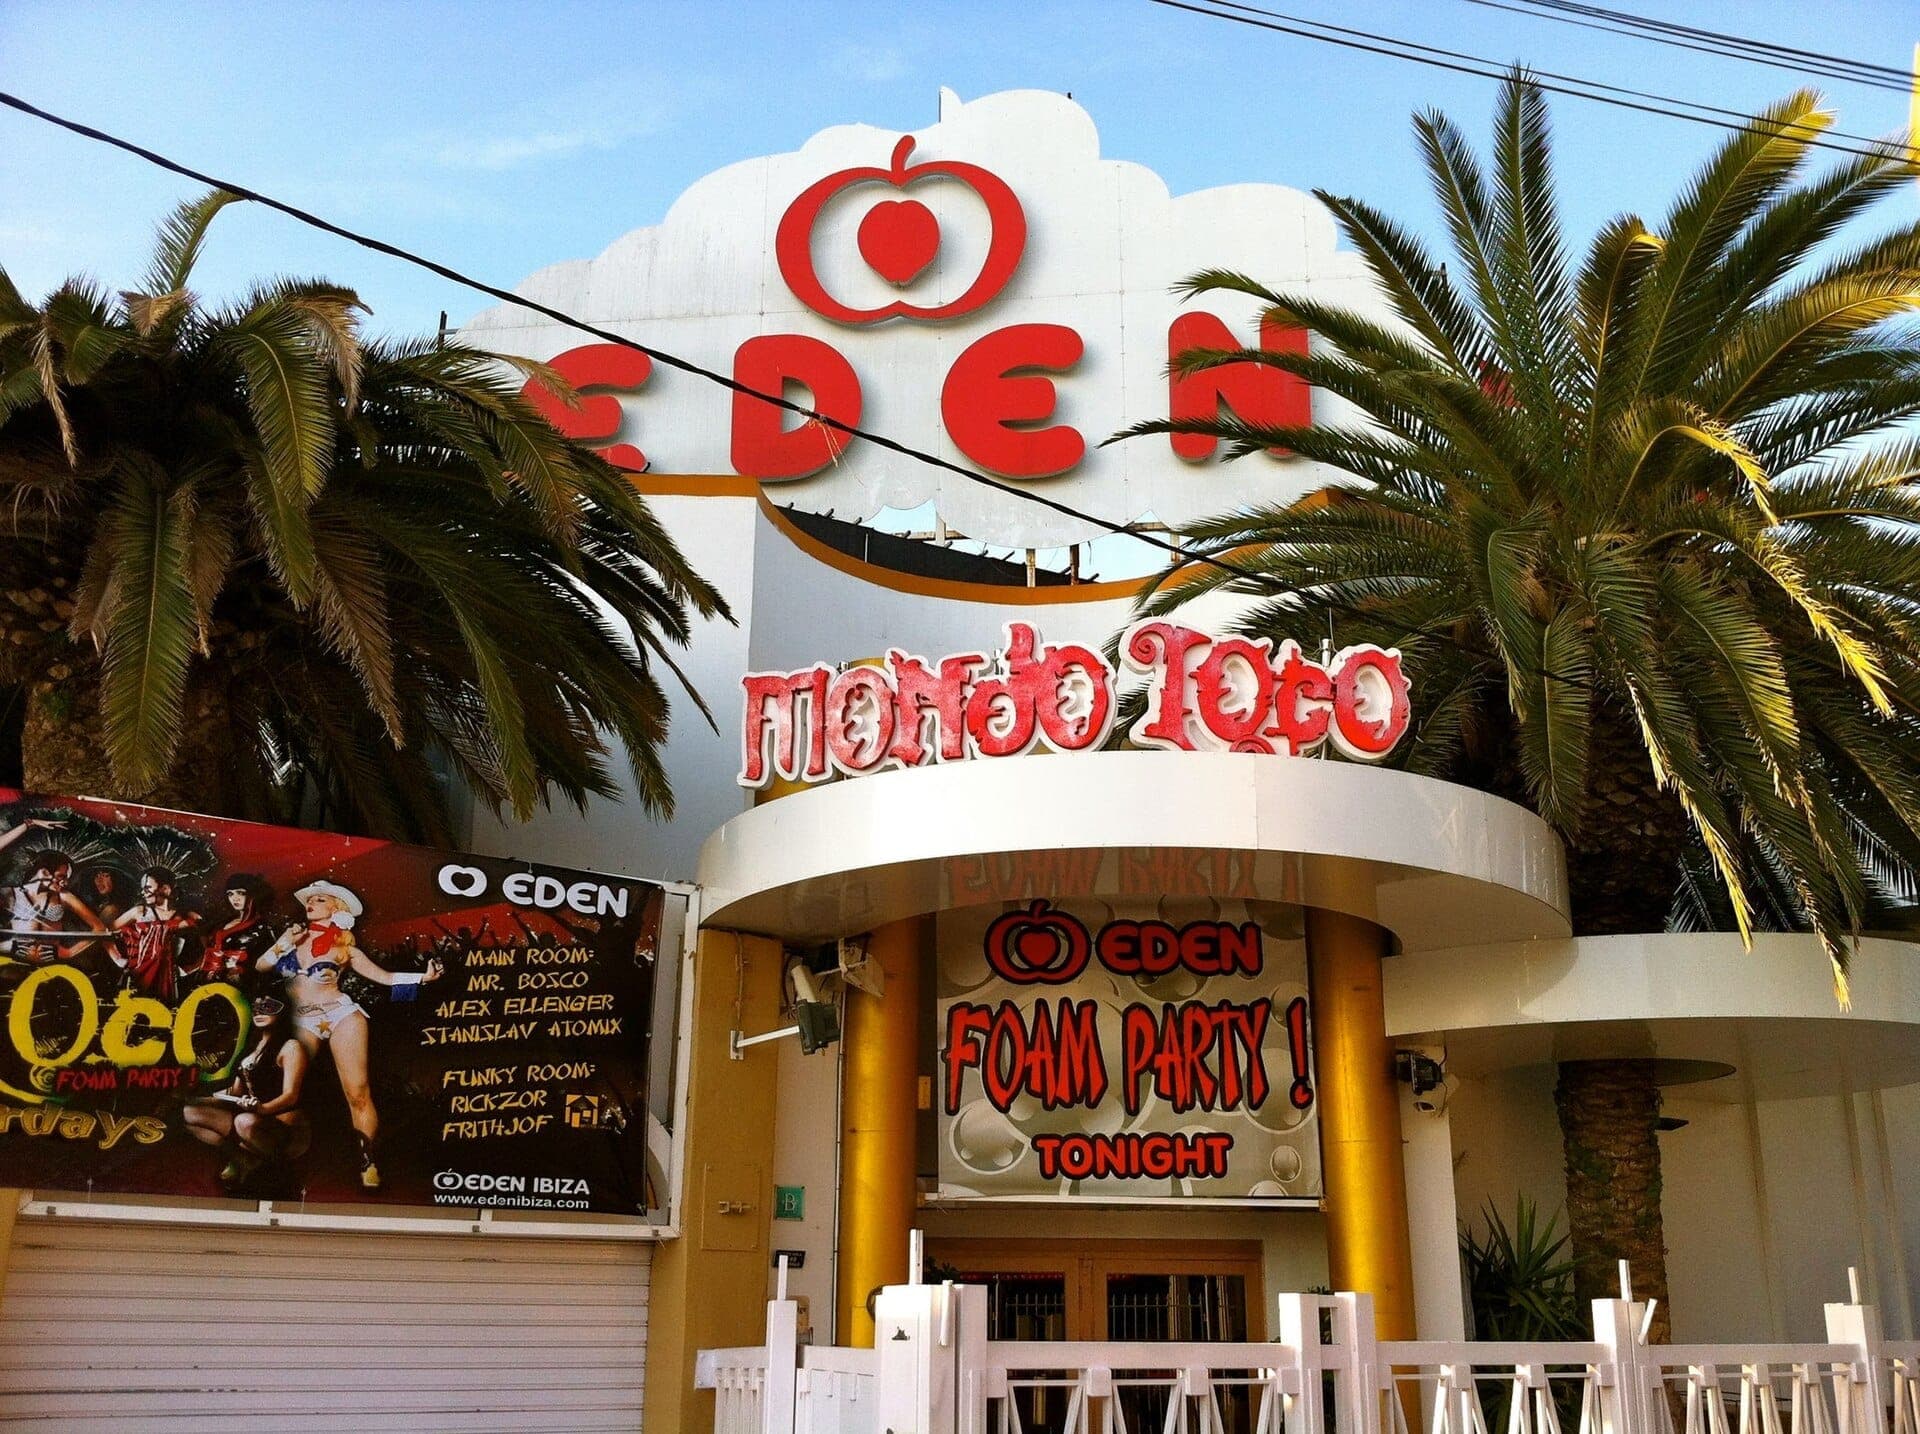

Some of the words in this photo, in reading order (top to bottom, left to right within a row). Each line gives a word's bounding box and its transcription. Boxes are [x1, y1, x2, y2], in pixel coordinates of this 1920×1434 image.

[520, 308, 1312, 481] EDEN
[502, 873, 628, 918] EDEN
[465, 950, 516, 967] MAIN
[526, 947, 595, 965] ROOM:
[1096, 919, 1263, 976] EDEN
[467, 974, 505, 992] MR.
[518, 971, 589, 990] BOSCO
[435, 999, 492, 1018] ALEX
[504, 994, 615, 1015] ELLENGER
[420, 1021, 538, 1046] STANISLAV
[547, 1017, 623, 1037] ATOMIX
[943, 998, 1108, 1115] FOAM
[1121, 998, 1271, 1114] PARTY
[56, 1070, 117, 1092] FOAM
[127, 1068, 182, 1089] PARTY
[443, 1066, 517, 1088] FUNKY
[527, 1062, 596, 1082] ROOM:
[451, 1090, 548, 1113] RICKZOR
[442, 1115, 554, 1141] FRITHJOF
[1032, 1132, 1234, 1179] TONIGHT
[464, 1174, 525, 1193] EDEN
[533, 1176, 590, 1195] IBIZA
[434, 1193, 590, 1209] www.edenibiza.com
[784, 1193, 797, 1212] B
